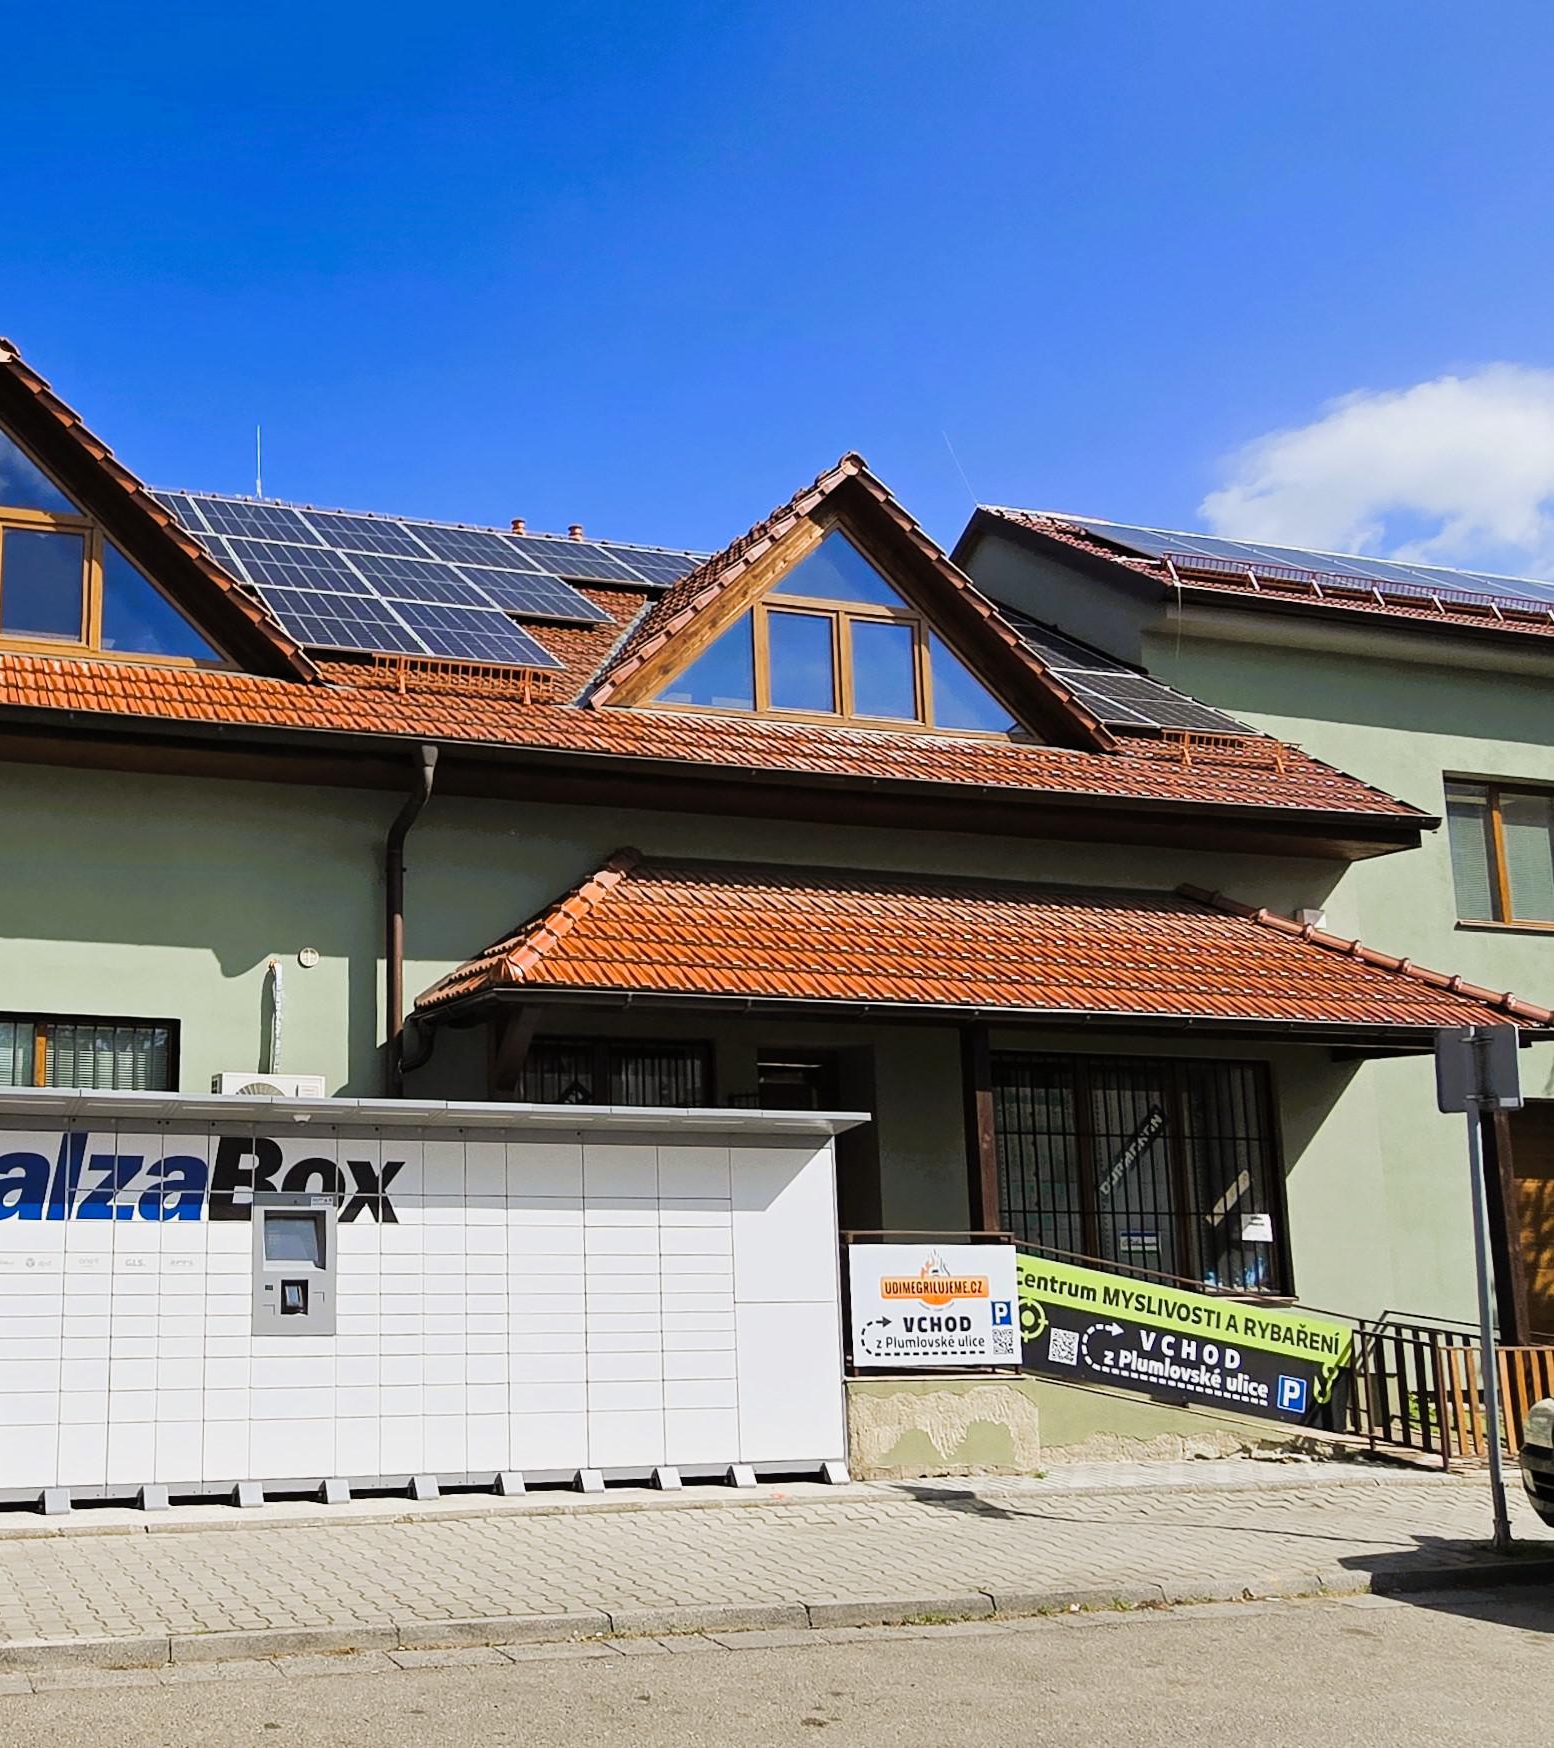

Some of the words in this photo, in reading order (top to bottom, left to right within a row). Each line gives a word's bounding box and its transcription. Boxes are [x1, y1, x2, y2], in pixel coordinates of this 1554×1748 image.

[884, 1280, 983, 1294] UDIMEGRILUJEME.CZ
[995, 1303, 1009, 1323] P
[1102, 1286, 1221, 1329] MYSLIVOSTI
[1225, 1314, 1239, 1334] A
[1244, 1317, 1340, 1355] RYBAŘENÍ
[903, 1317, 972, 1333] VCHOD
[876, 1339, 883, 1349] z
[886, 1335, 955, 1349] Plumlovské
[958, 1334, 985, 1348] ulice
[1140, 1330, 1241, 1369] VCHOD
[1103, 1350, 1115, 1365] z
[1119, 1350, 1222, 1390] Plumlovské
[1226, 1372, 1269, 1399] ulice
[1282, 1380, 1301, 1407] P
